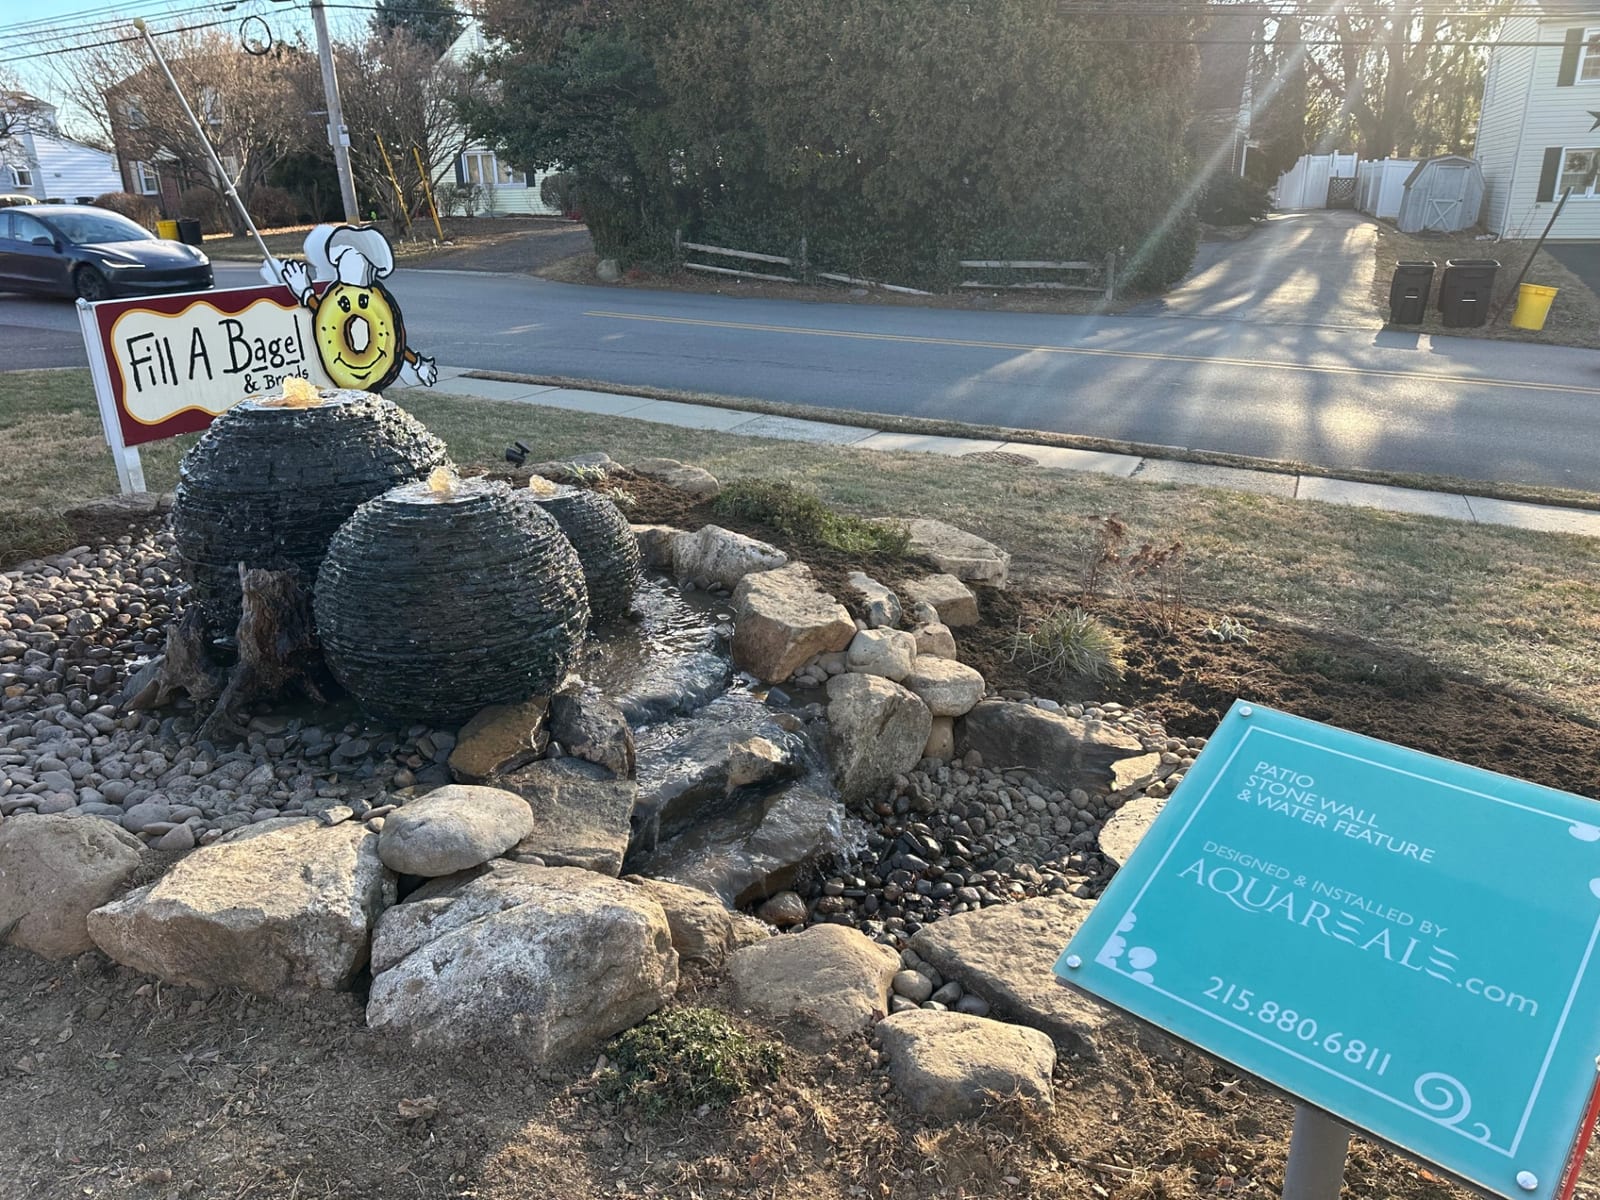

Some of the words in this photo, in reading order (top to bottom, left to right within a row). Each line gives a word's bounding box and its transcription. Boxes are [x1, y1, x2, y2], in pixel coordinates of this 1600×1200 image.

[126, 332, 178, 392] Fill
[189, 327, 213, 380] A
[218, 314, 305, 373] Bagel
[244, 373, 261, 393] &
[1245, 775, 1317, 807] STONE
[1321, 797, 1379, 828] WALL
[1254, 761, 1314, 788] PATIO
[1237, 788, 1251, 802] &
[1257, 793, 1328, 828] WATER
[1333, 820, 1436, 864] FEATURE
[1202, 840, 1290, 880] DESIGNED
[1294, 874, 1307, 888] &
[1311, 880, 1414, 926] INSTALLED
[1418, 920, 1448, 938] BY
[1202, 976, 1391, 1076] 215.880.6811
